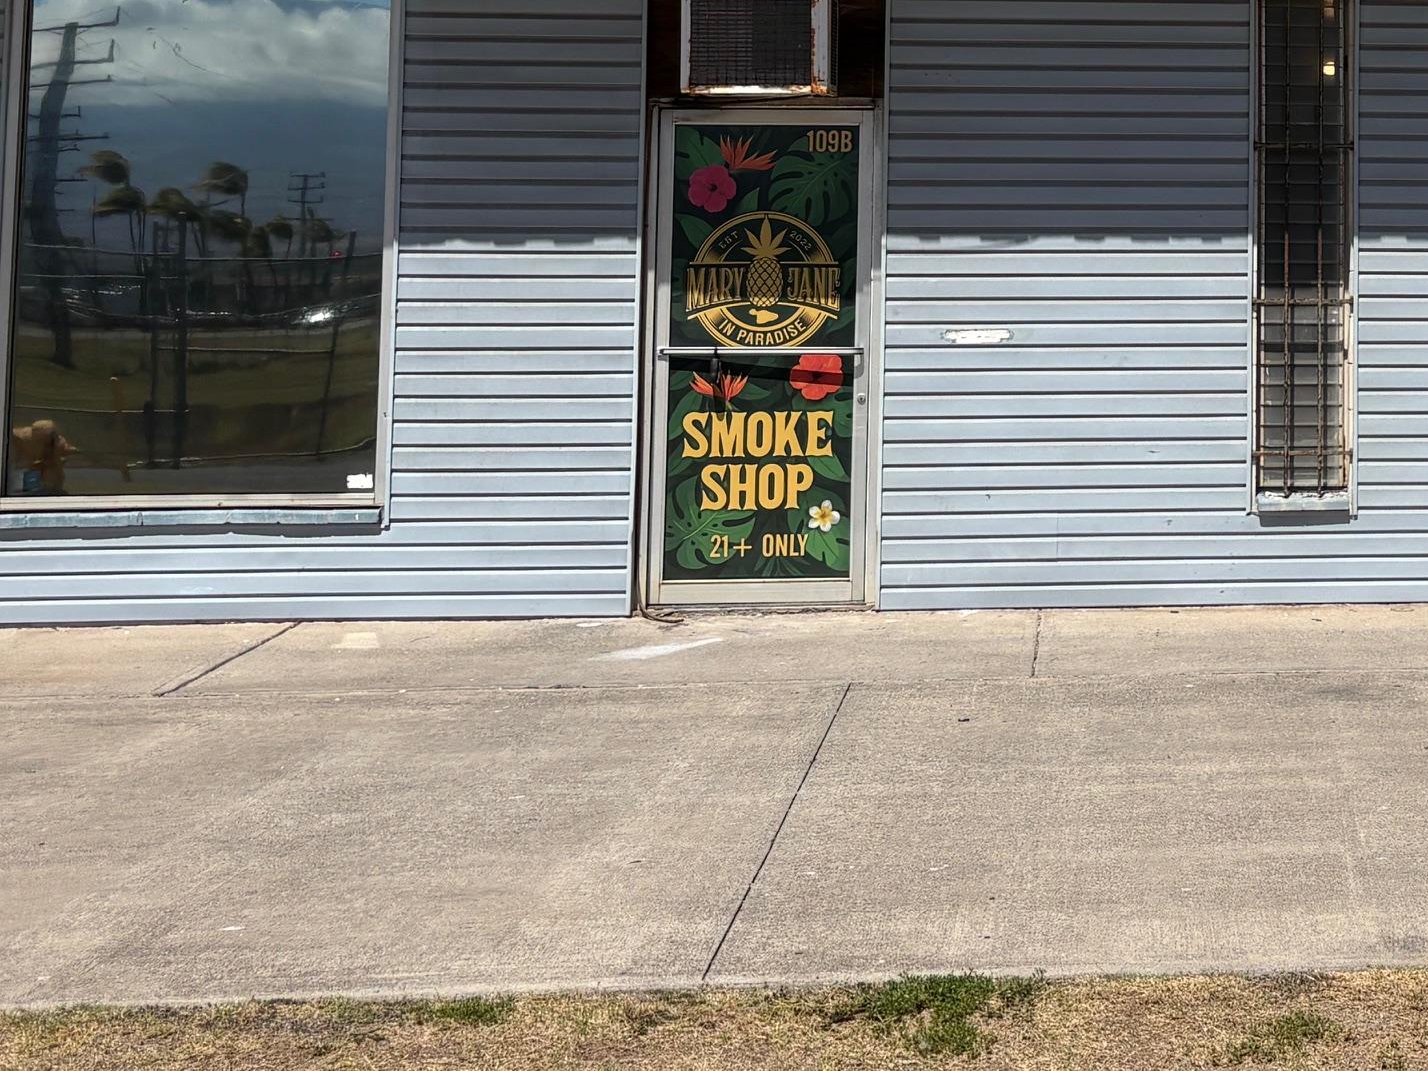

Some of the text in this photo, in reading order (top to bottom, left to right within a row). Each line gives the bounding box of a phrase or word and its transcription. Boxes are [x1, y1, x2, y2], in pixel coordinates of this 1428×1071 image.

[806, 129, 853, 153] 109B
[789, 230, 812, 250] 2022
[686, 267, 841, 311] MARY JANE
[718, 319, 807, 346] IN PARADISE
[682, 410, 834, 458] SMOKE
[700, 463, 814, 511] SHOP
[710, 533, 809, 558] 21+ ONLY
